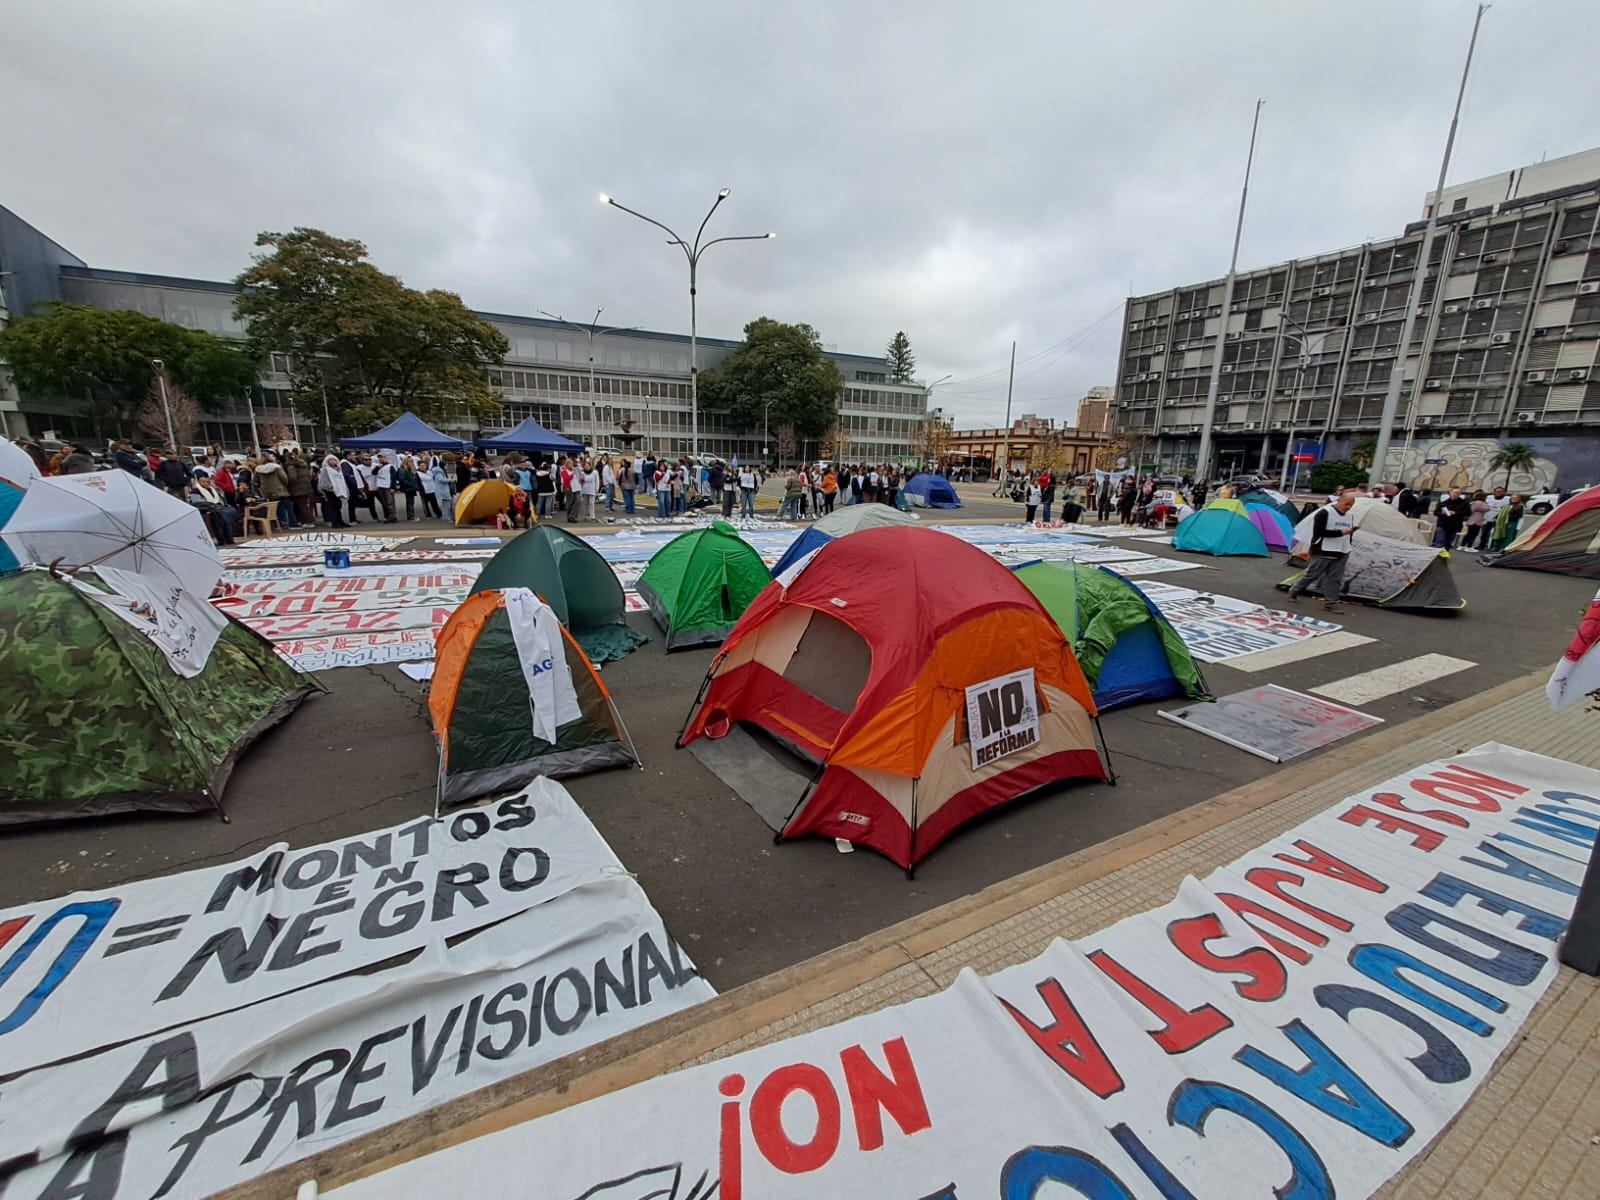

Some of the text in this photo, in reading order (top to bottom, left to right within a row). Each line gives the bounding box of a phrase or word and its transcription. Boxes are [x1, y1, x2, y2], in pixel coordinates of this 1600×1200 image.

[533, 656, 554, 676] AG
[977, 681, 1024, 738] NO
[976, 727, 1036, 765] REFORMA
[203, 793, 537, 914] MONTOS
[313, 860, 419, 905] EN
[152, 846, 551, 1005] NEGRO
[995, 839, 1390, 1099] AJUSTA
[919, 870, 1570, 1200] EDUCACI
